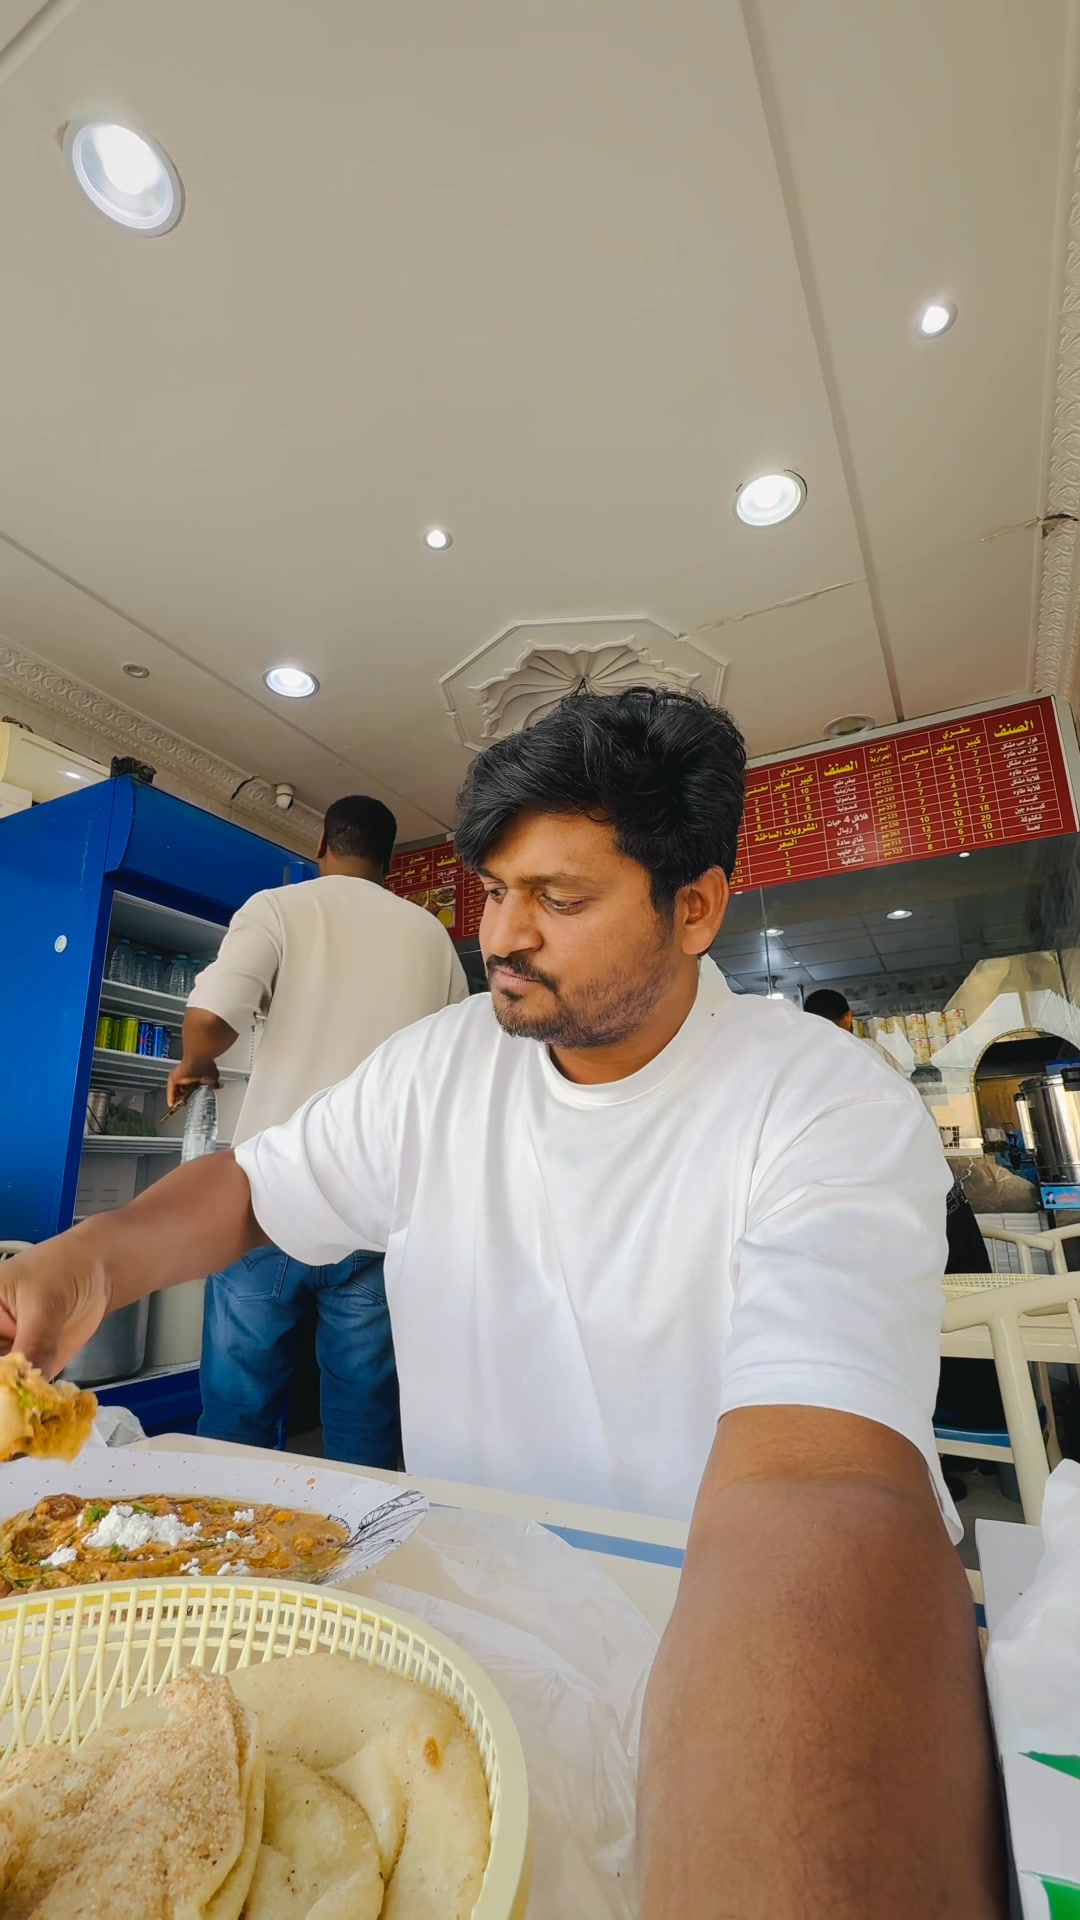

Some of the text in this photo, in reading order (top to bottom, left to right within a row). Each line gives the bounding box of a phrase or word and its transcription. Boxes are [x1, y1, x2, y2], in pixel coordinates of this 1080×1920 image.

[994, 719, 1034, 738] الصنف
[964, 736, 981, 748] كبير
[935, 744, 955, 756] صغير
[824, 760, 858, 776] الصنف
[799, 774, 814, 786] كبير
[774, 781, 790, 792] صغير
[844, 816, 850, 824] 4
[754, 822, 818, 842] المشروبات الساخنة
[837, 822, 860, 836] 1 ريال
[777, 838, 798, 851] السعر
[852, 835, 864, 846] شاي
[836, 845, 866, 857] شاي حليب
